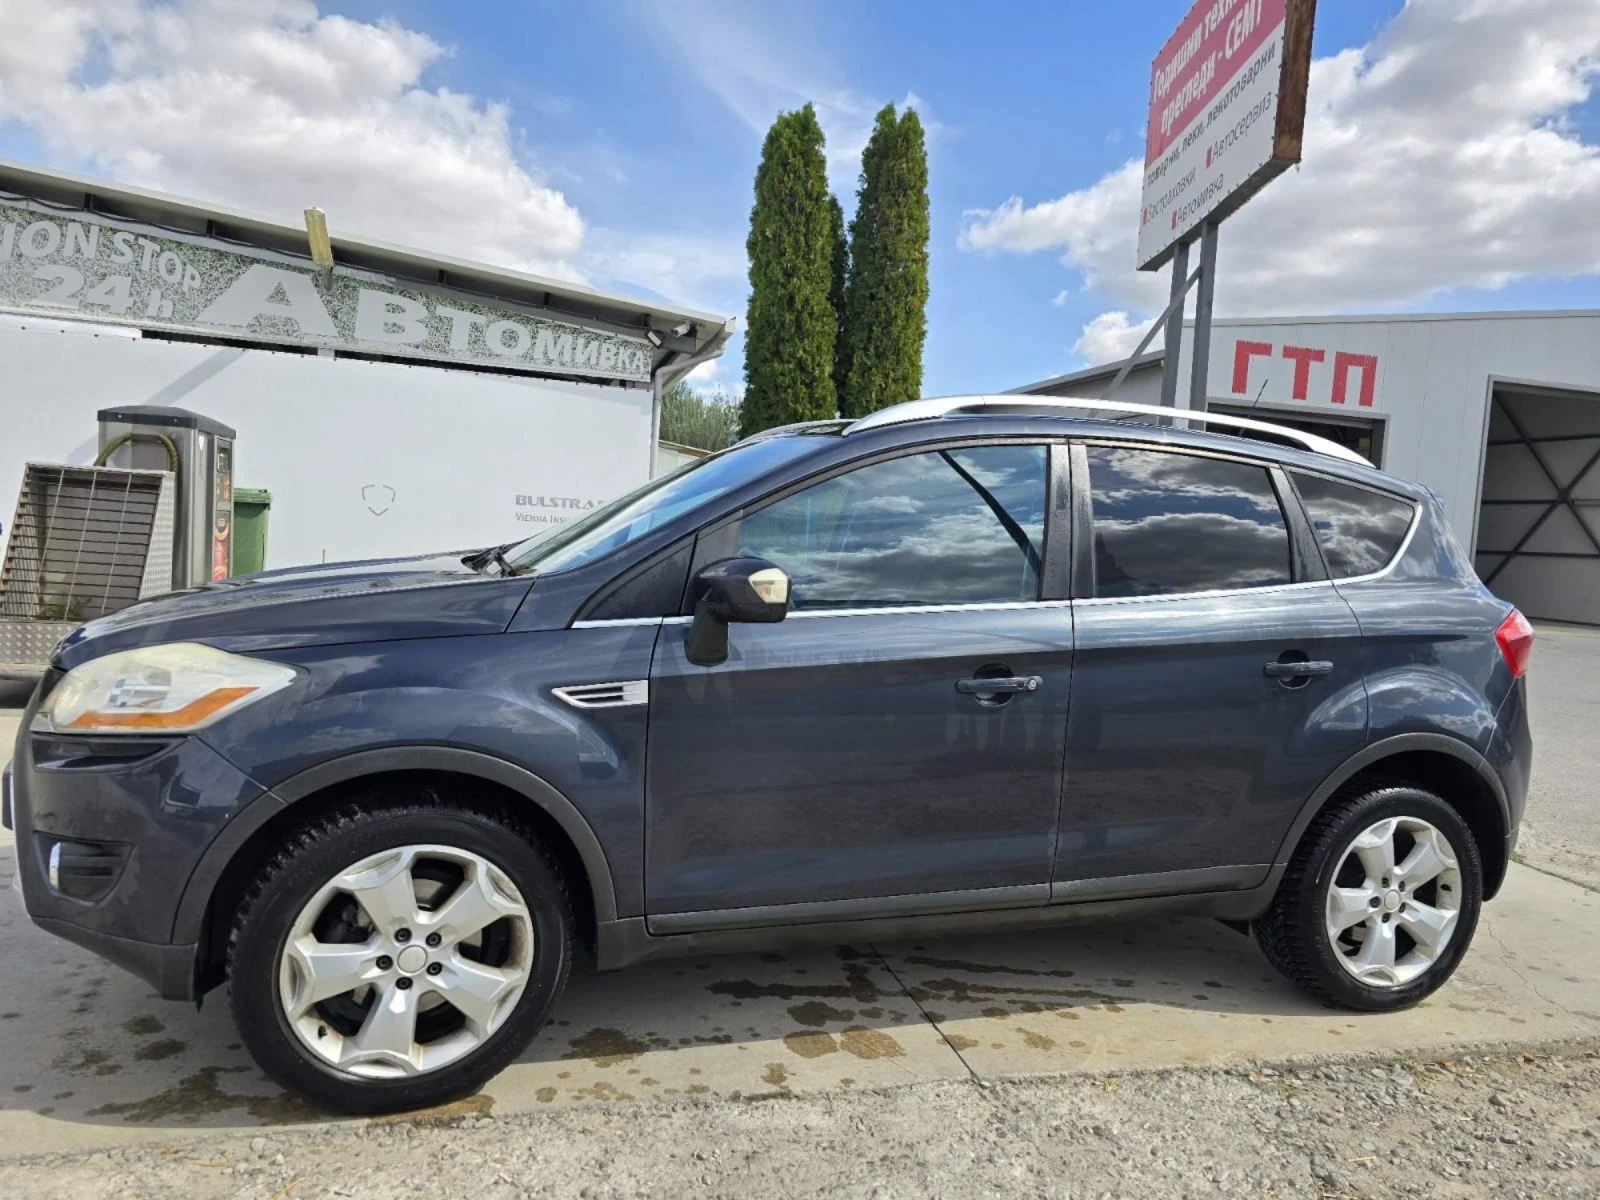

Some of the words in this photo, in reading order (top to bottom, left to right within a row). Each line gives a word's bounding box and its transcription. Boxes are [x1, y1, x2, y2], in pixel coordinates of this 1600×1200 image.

[1153, 22, 1203, 104] Годишни
[1204, 0, 1238, 40] техн
[1206, 41, 1276, 129] лекотоварни
[1161, 50, 1216, 137] прегледи
[1211, 91, 1272, 164] Автосервиз
[1149, 167, 1196, 222] Застраховки
[1177, 173, 1224, 224] Автомивка
[30, 264, 135, 313] 24
[147, 288, 174, 319] h
[110, 231, 201, 293] STOP
[196, 263, 647, 372] АВТОМИВКА
[1232, 339, 1378, 407] ГТП
[515, 494, 604, 510] BULSTRA
